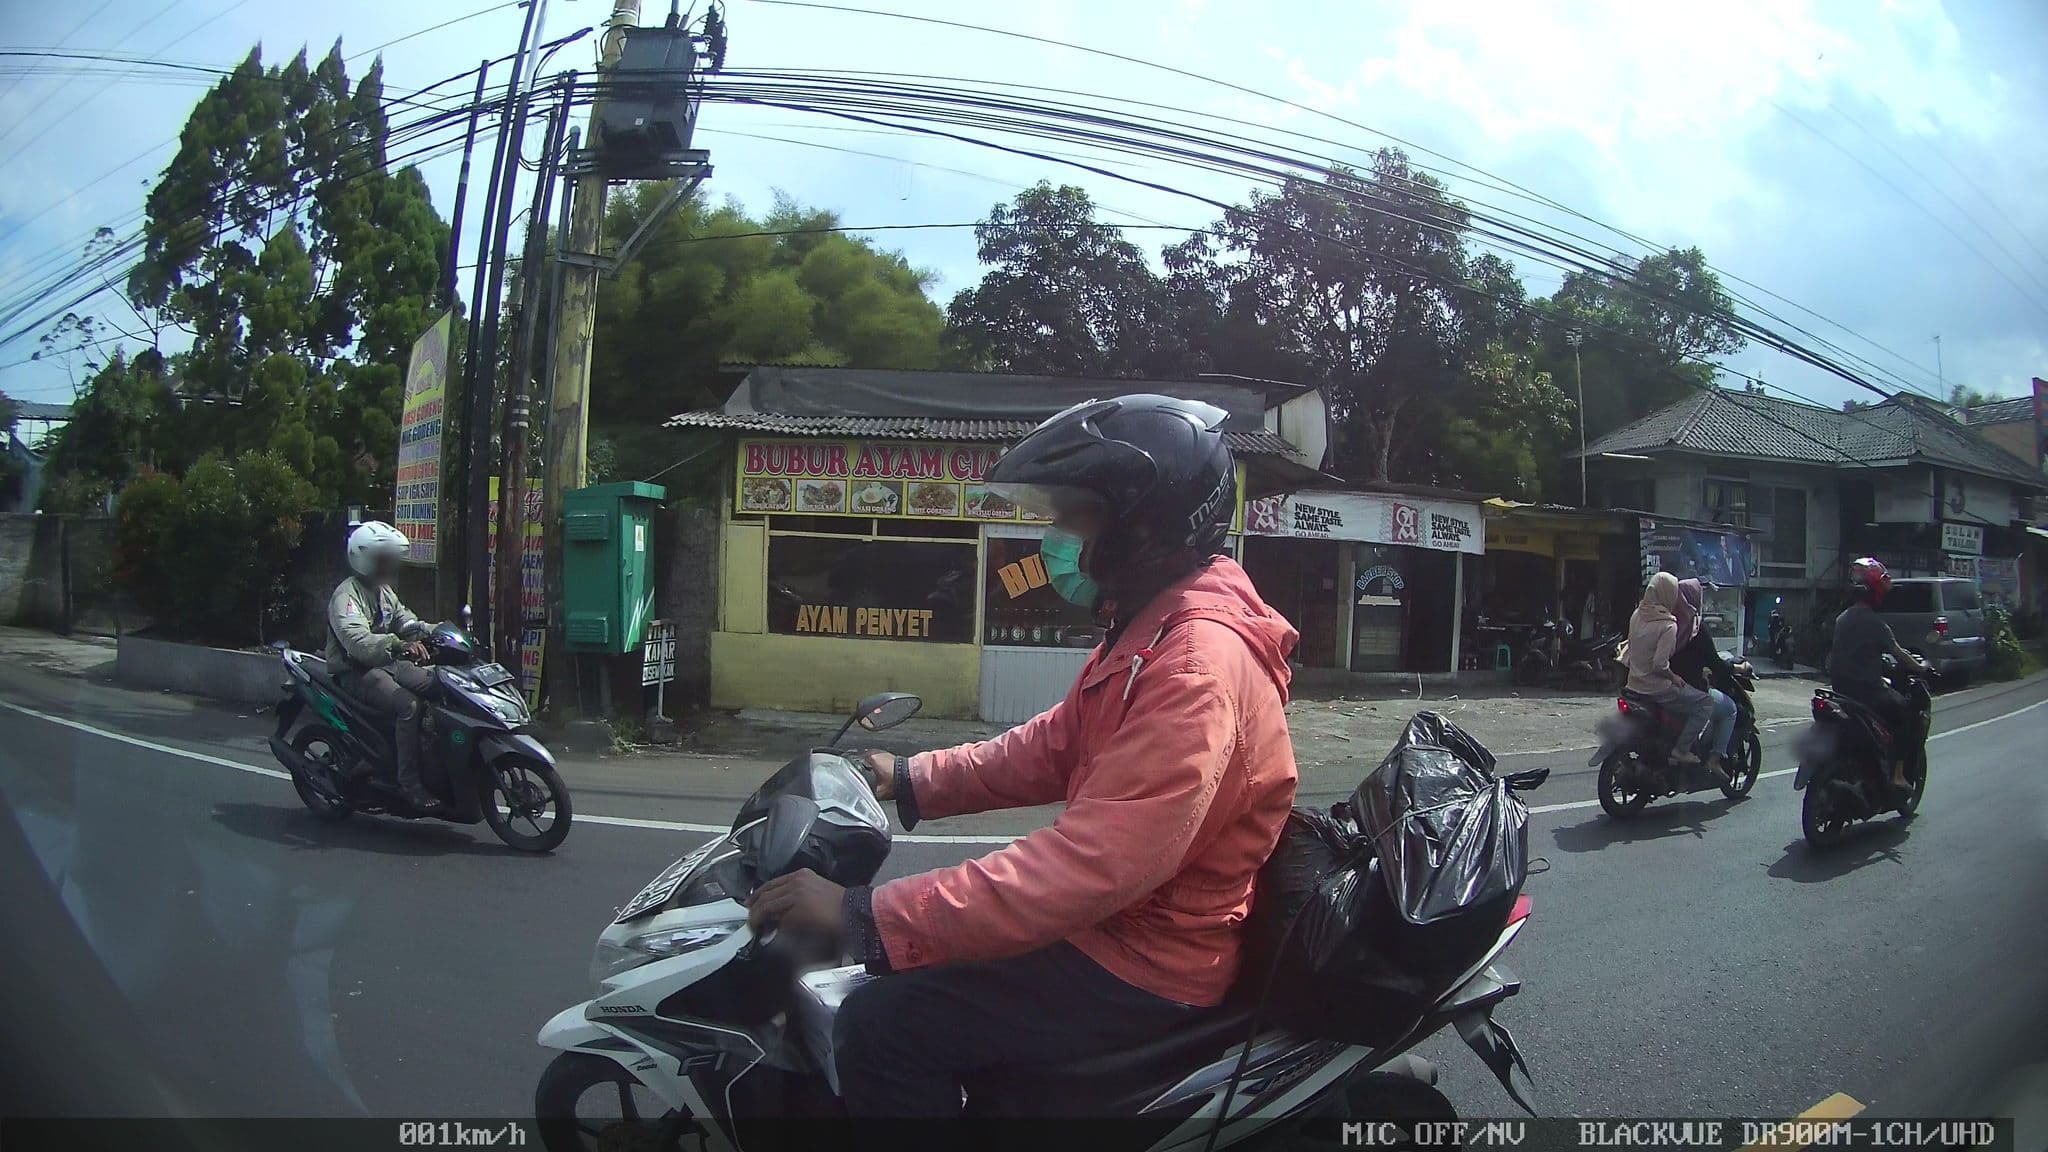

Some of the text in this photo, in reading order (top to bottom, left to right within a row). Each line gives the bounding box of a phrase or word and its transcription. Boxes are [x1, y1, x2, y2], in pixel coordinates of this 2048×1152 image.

[413, 418, 442, 442] GORENG
[744, 443, 850, 477] BUBUR
[853, 445, 944, 479] AYAM
[420, 482, 438, 499] SAPI
[1294, 502, 1317, 514] NEW
[1294, 512, 1320, 523] SAME
[1431, 512, 1450, 525] NEW
[1431, 521, 1454, 533] SAME
[1295, 530, 1307, 538] GO
[1432, 540, 1443, 548] GO
[998, 553, 1051, 599] BU
[1387, 567, 1405, 590] SHOP
[796, 604, 933, 637] AYAM PENYET
[600, 1005, 648, 1014] HONDA
